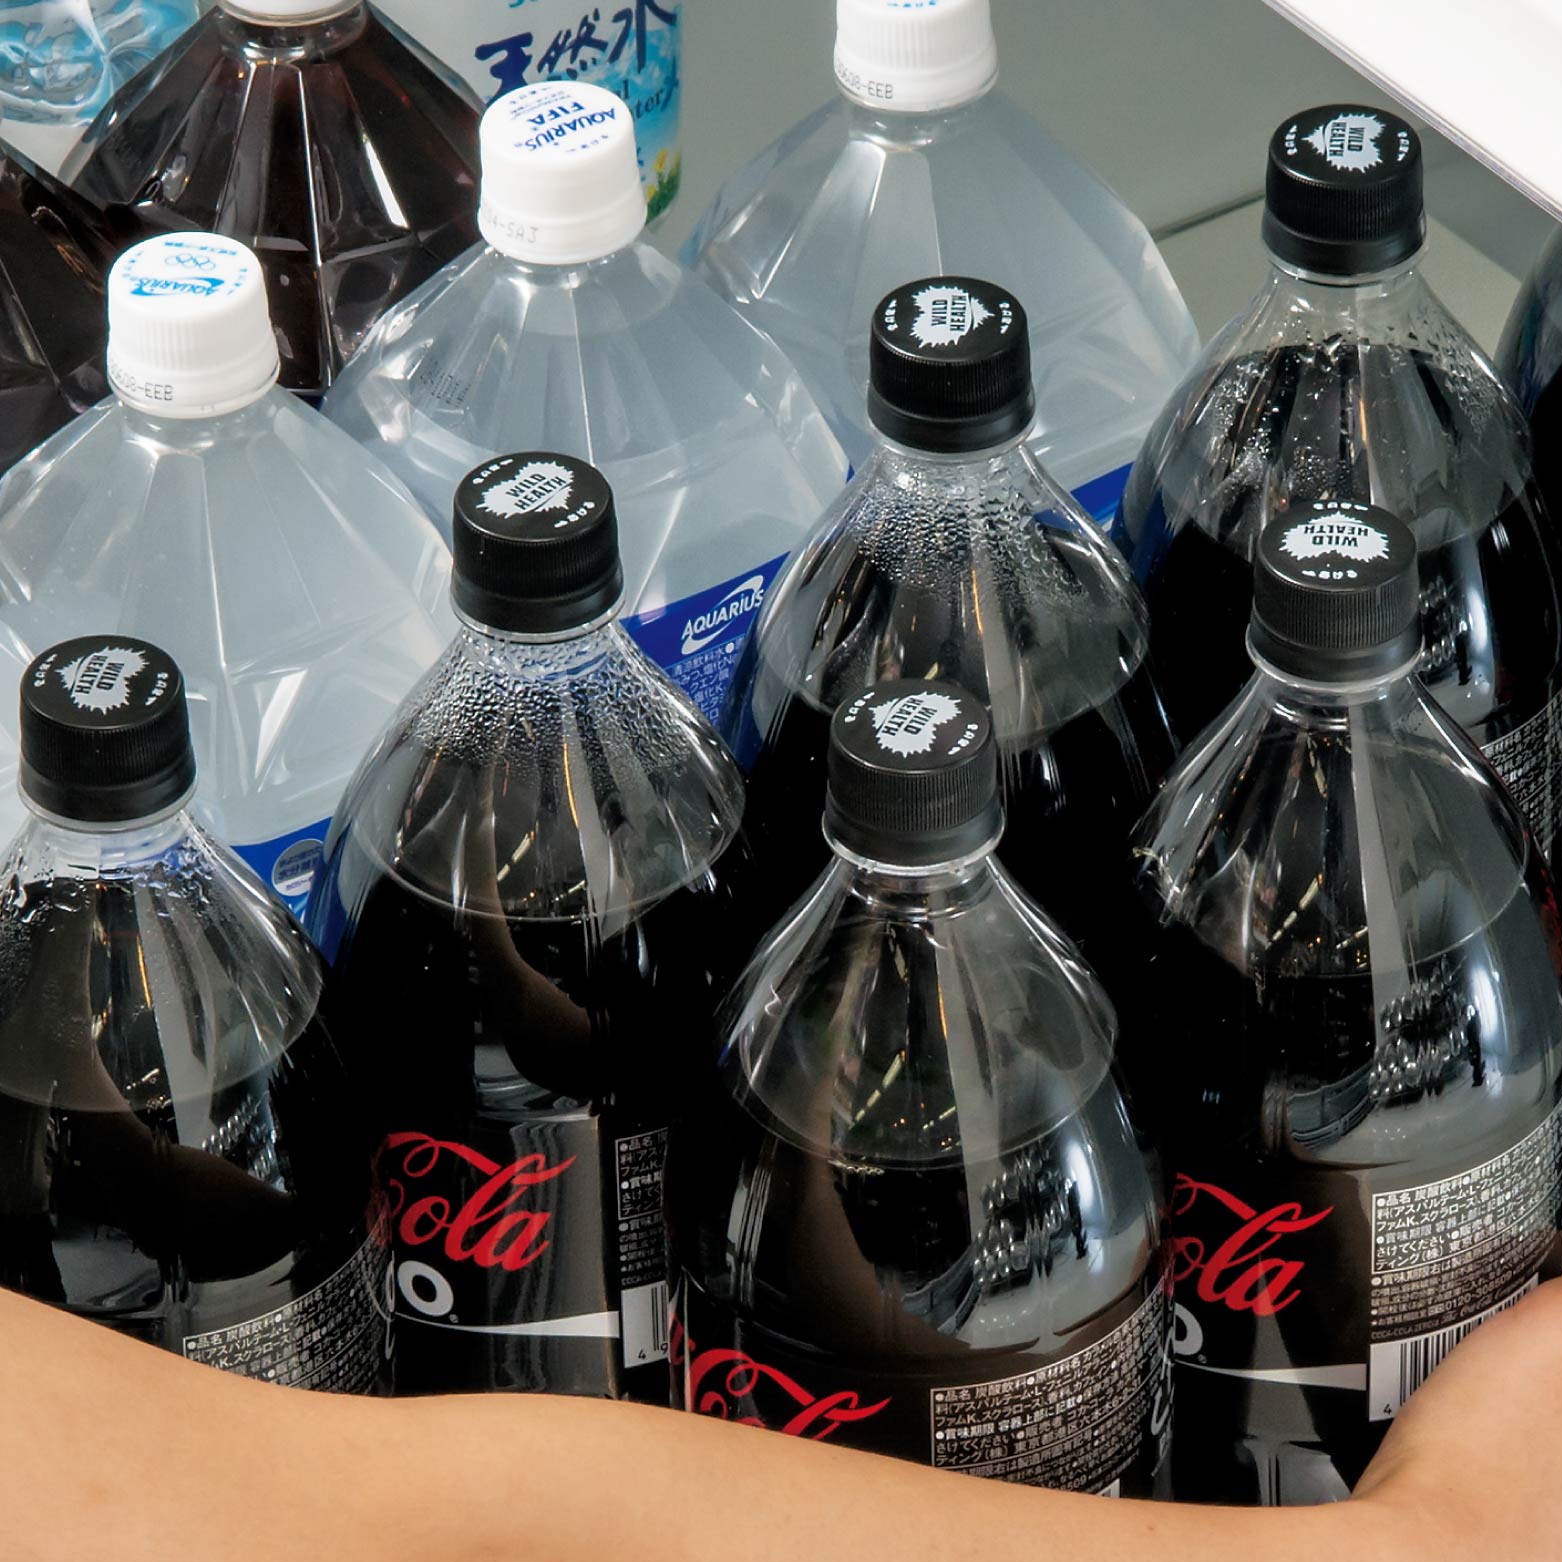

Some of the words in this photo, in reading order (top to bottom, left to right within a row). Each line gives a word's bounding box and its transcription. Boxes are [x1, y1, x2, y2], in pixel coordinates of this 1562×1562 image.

[527, 101, 585, 126] FIFA
[636, 88, 664, 119] ter
[1329, 121, 1347, 157] HEALTH
[1348, 127, 1365, 152] WILD
[931, 299, 948, 326] WILD
[950, 294, 967, 332] HEALTH
[506, 473, 546, 498] WILD
[514, 476, 567, 510] HEALTH
[1304, 525, 1369, 537] HEALTH
[1312, 535, 1359, 547] WILD
[75, 654, 109, 695] HEALTH
[95, 662, 125, 691] WILD
[882, 697, 924, 736] HEALTH
[904, 706, 937, 735] WILD
[946, 1388, 971, 1401] 品名
[1383, 1403, 1392, 1415] 4
[935, 1431, 1017, 1455] さけてください
[946, 1422, 995, 1440] 賞味期限
